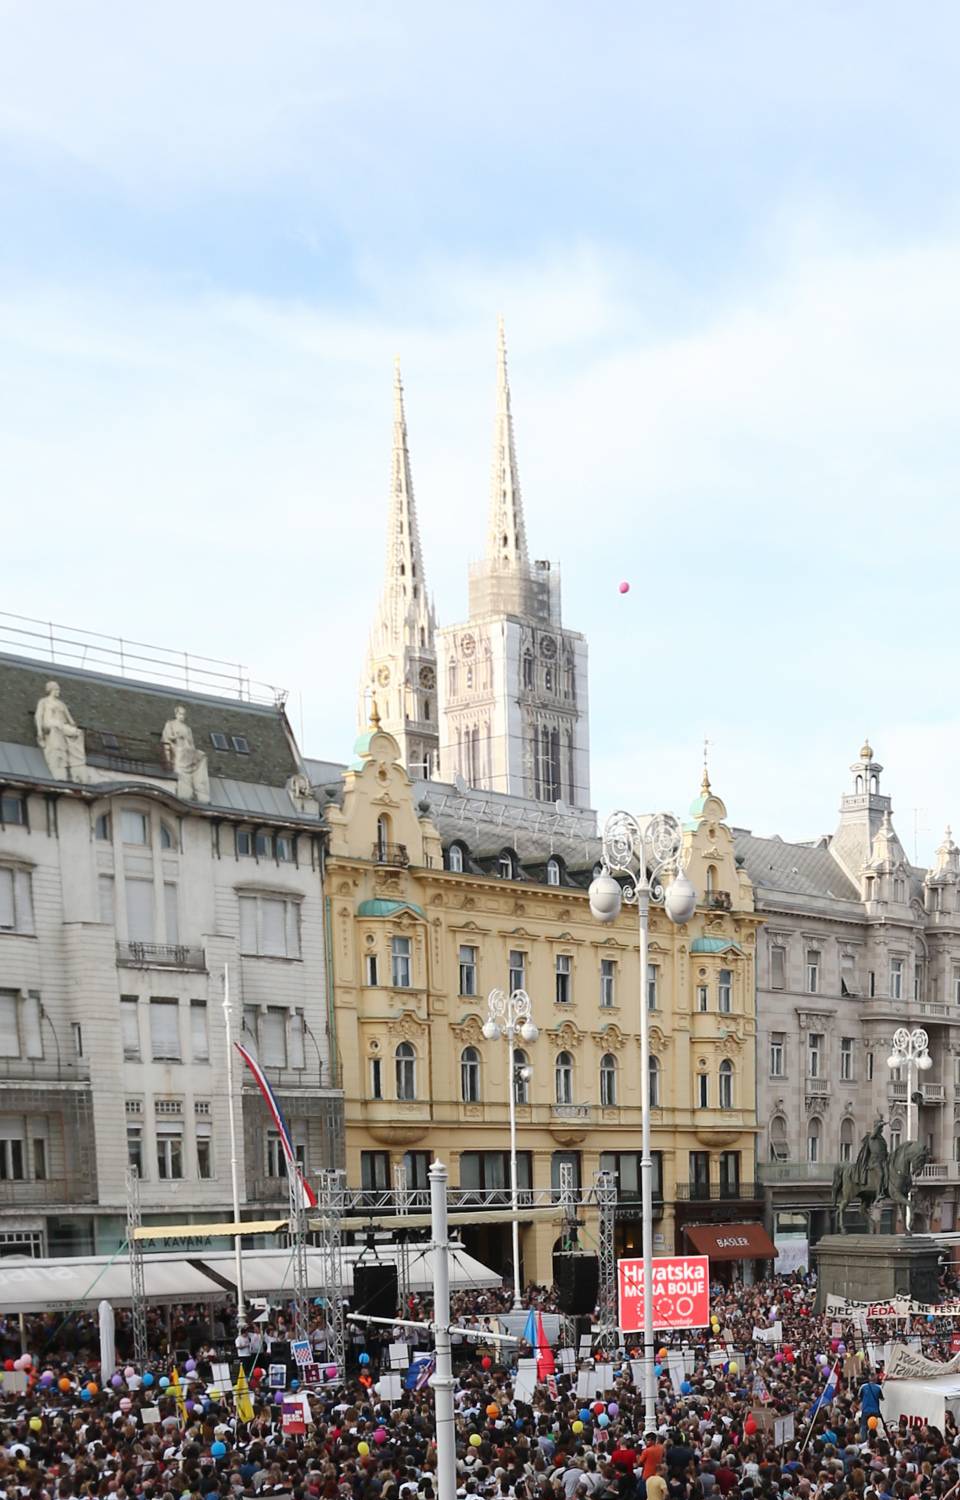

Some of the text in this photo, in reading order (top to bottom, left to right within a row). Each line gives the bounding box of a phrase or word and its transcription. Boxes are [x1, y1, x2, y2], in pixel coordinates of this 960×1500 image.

[164, 1236, 212, 1249] KAVANA
[717, 1237, 750, 1247] BASLER
[668, 1282, 705, 1296] BOLJE
[917, 1304, 931, 1312] NE
